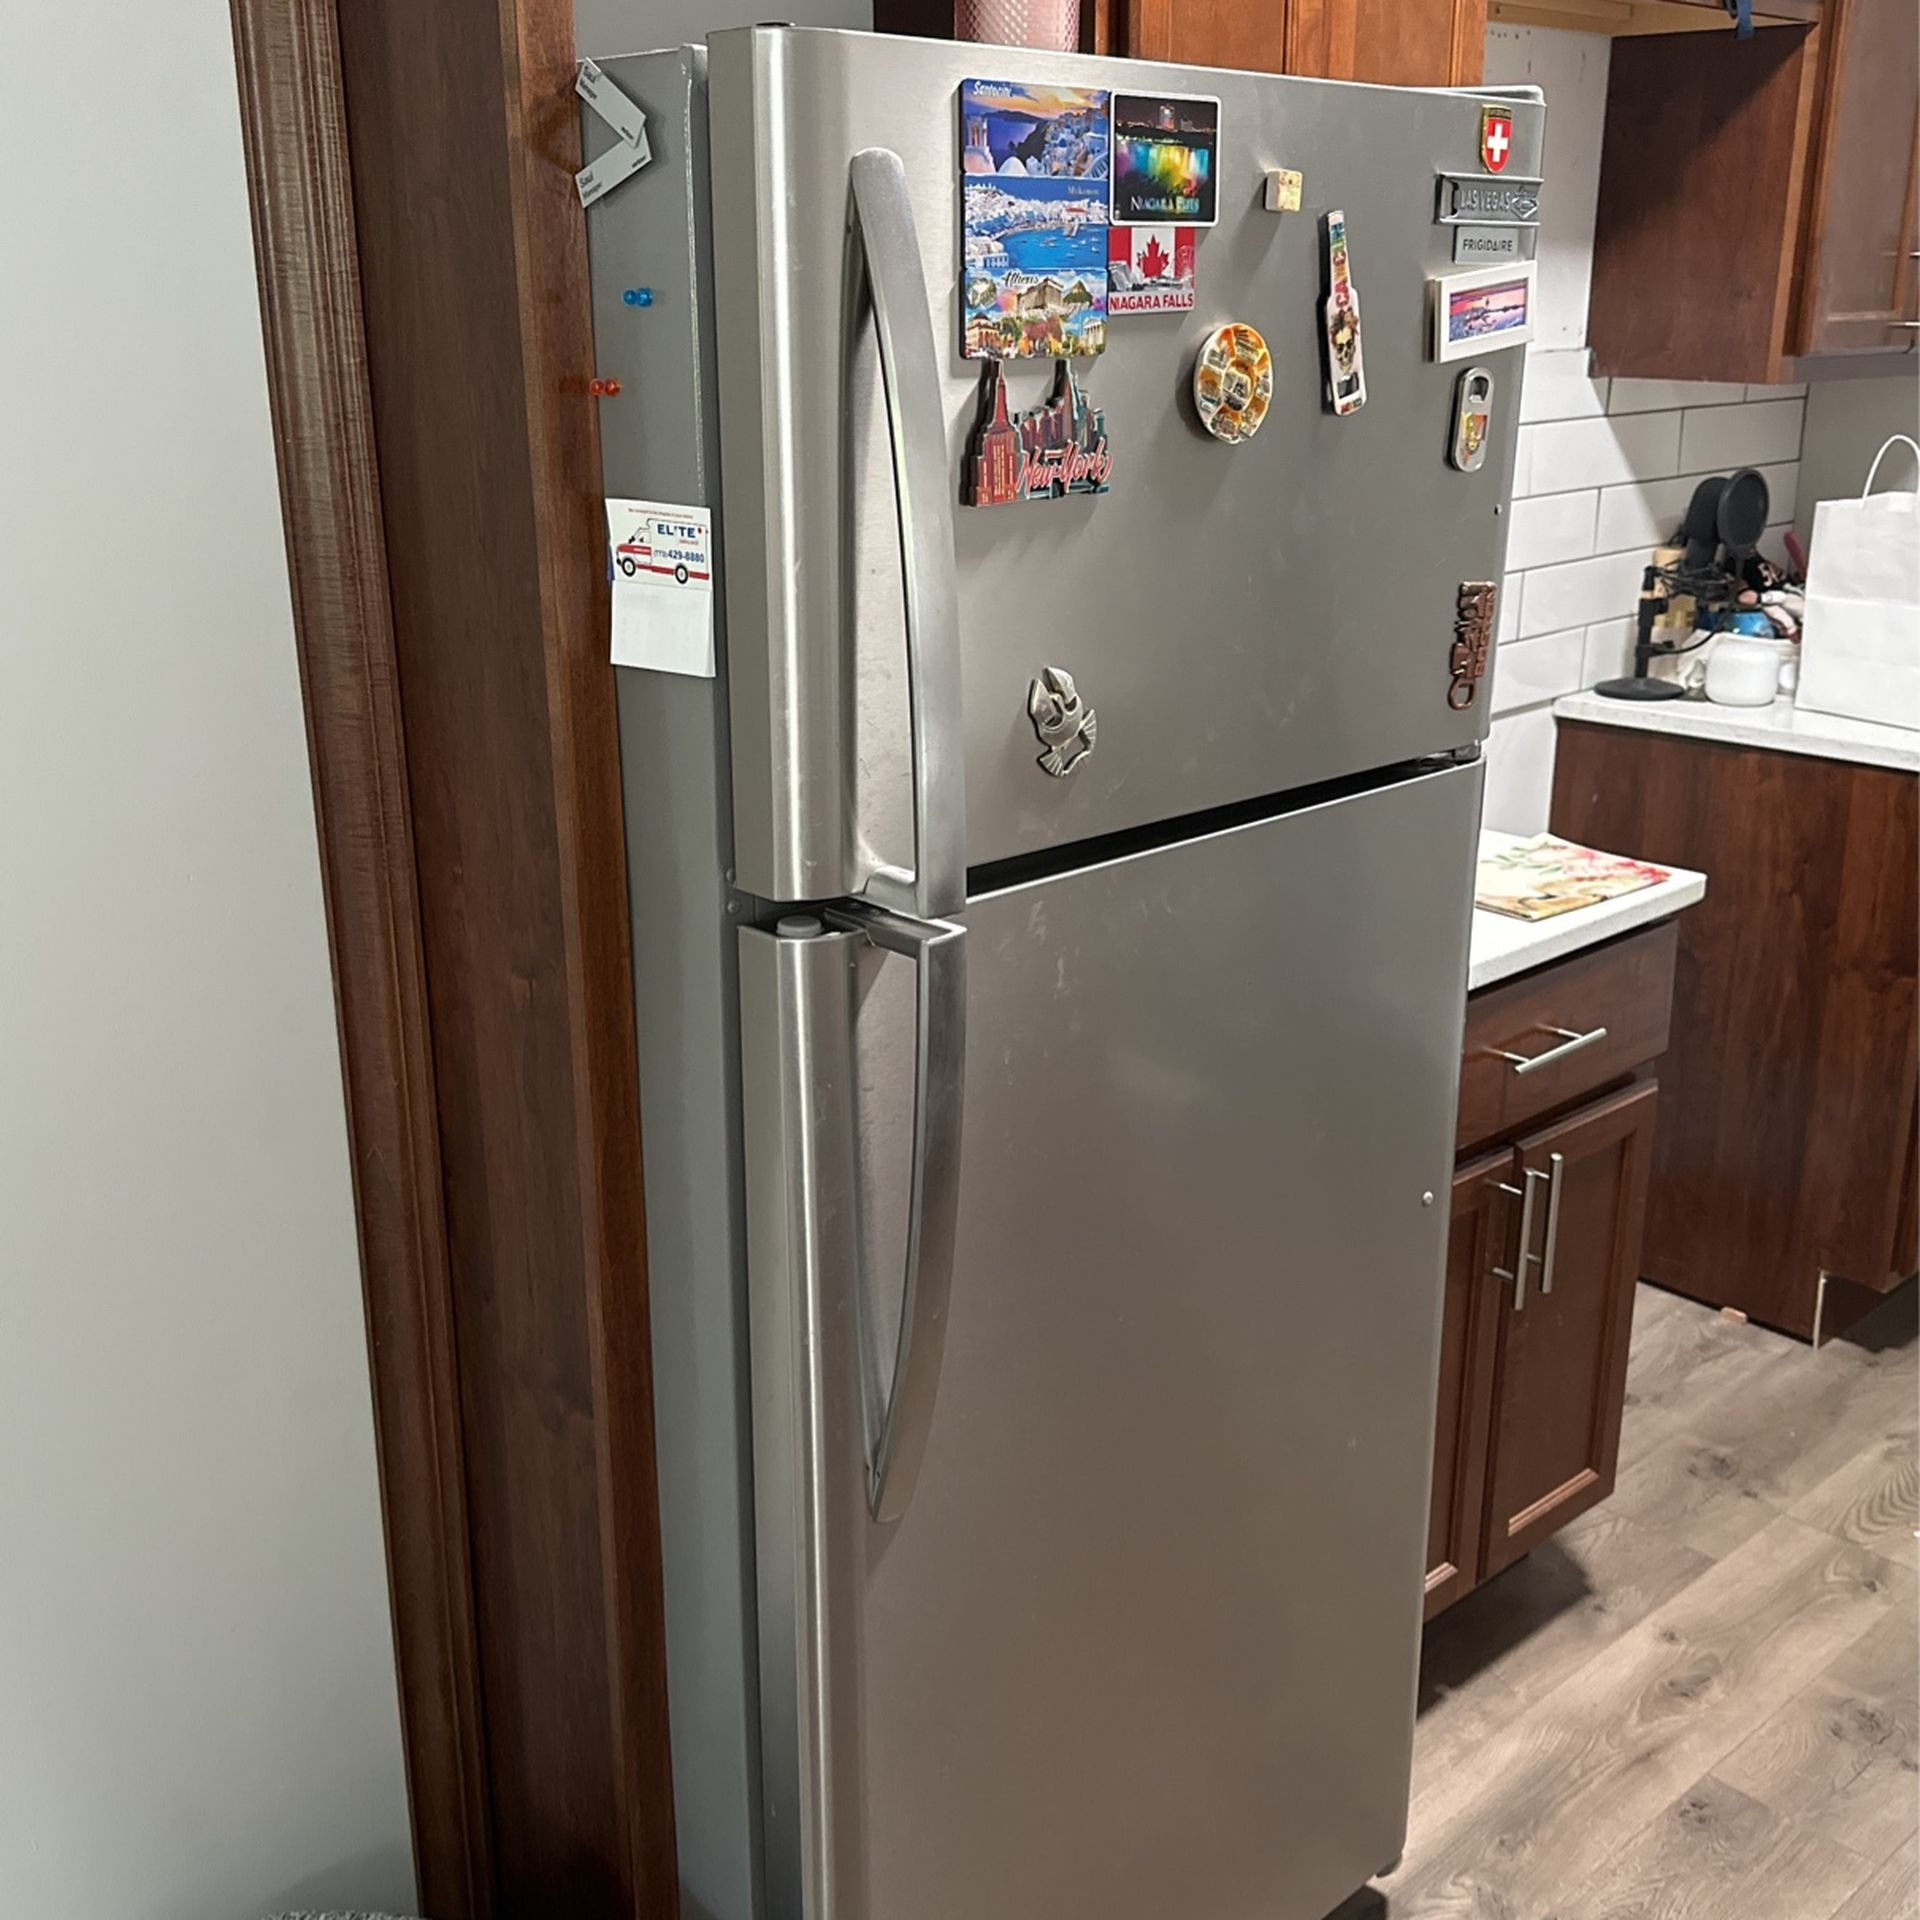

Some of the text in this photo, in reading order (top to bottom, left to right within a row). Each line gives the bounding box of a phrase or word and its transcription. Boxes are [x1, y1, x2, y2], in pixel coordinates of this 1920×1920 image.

[1480, 191, 1511, 211] VEGAS
[1462, 238, 1513, 252] FRIGIDAIRE
[1001, 270, 1039, 288] Athens
[1109, 293, 1194, 310] NIAGARA FALLS
[1016, 437, 1113, 499] New York
